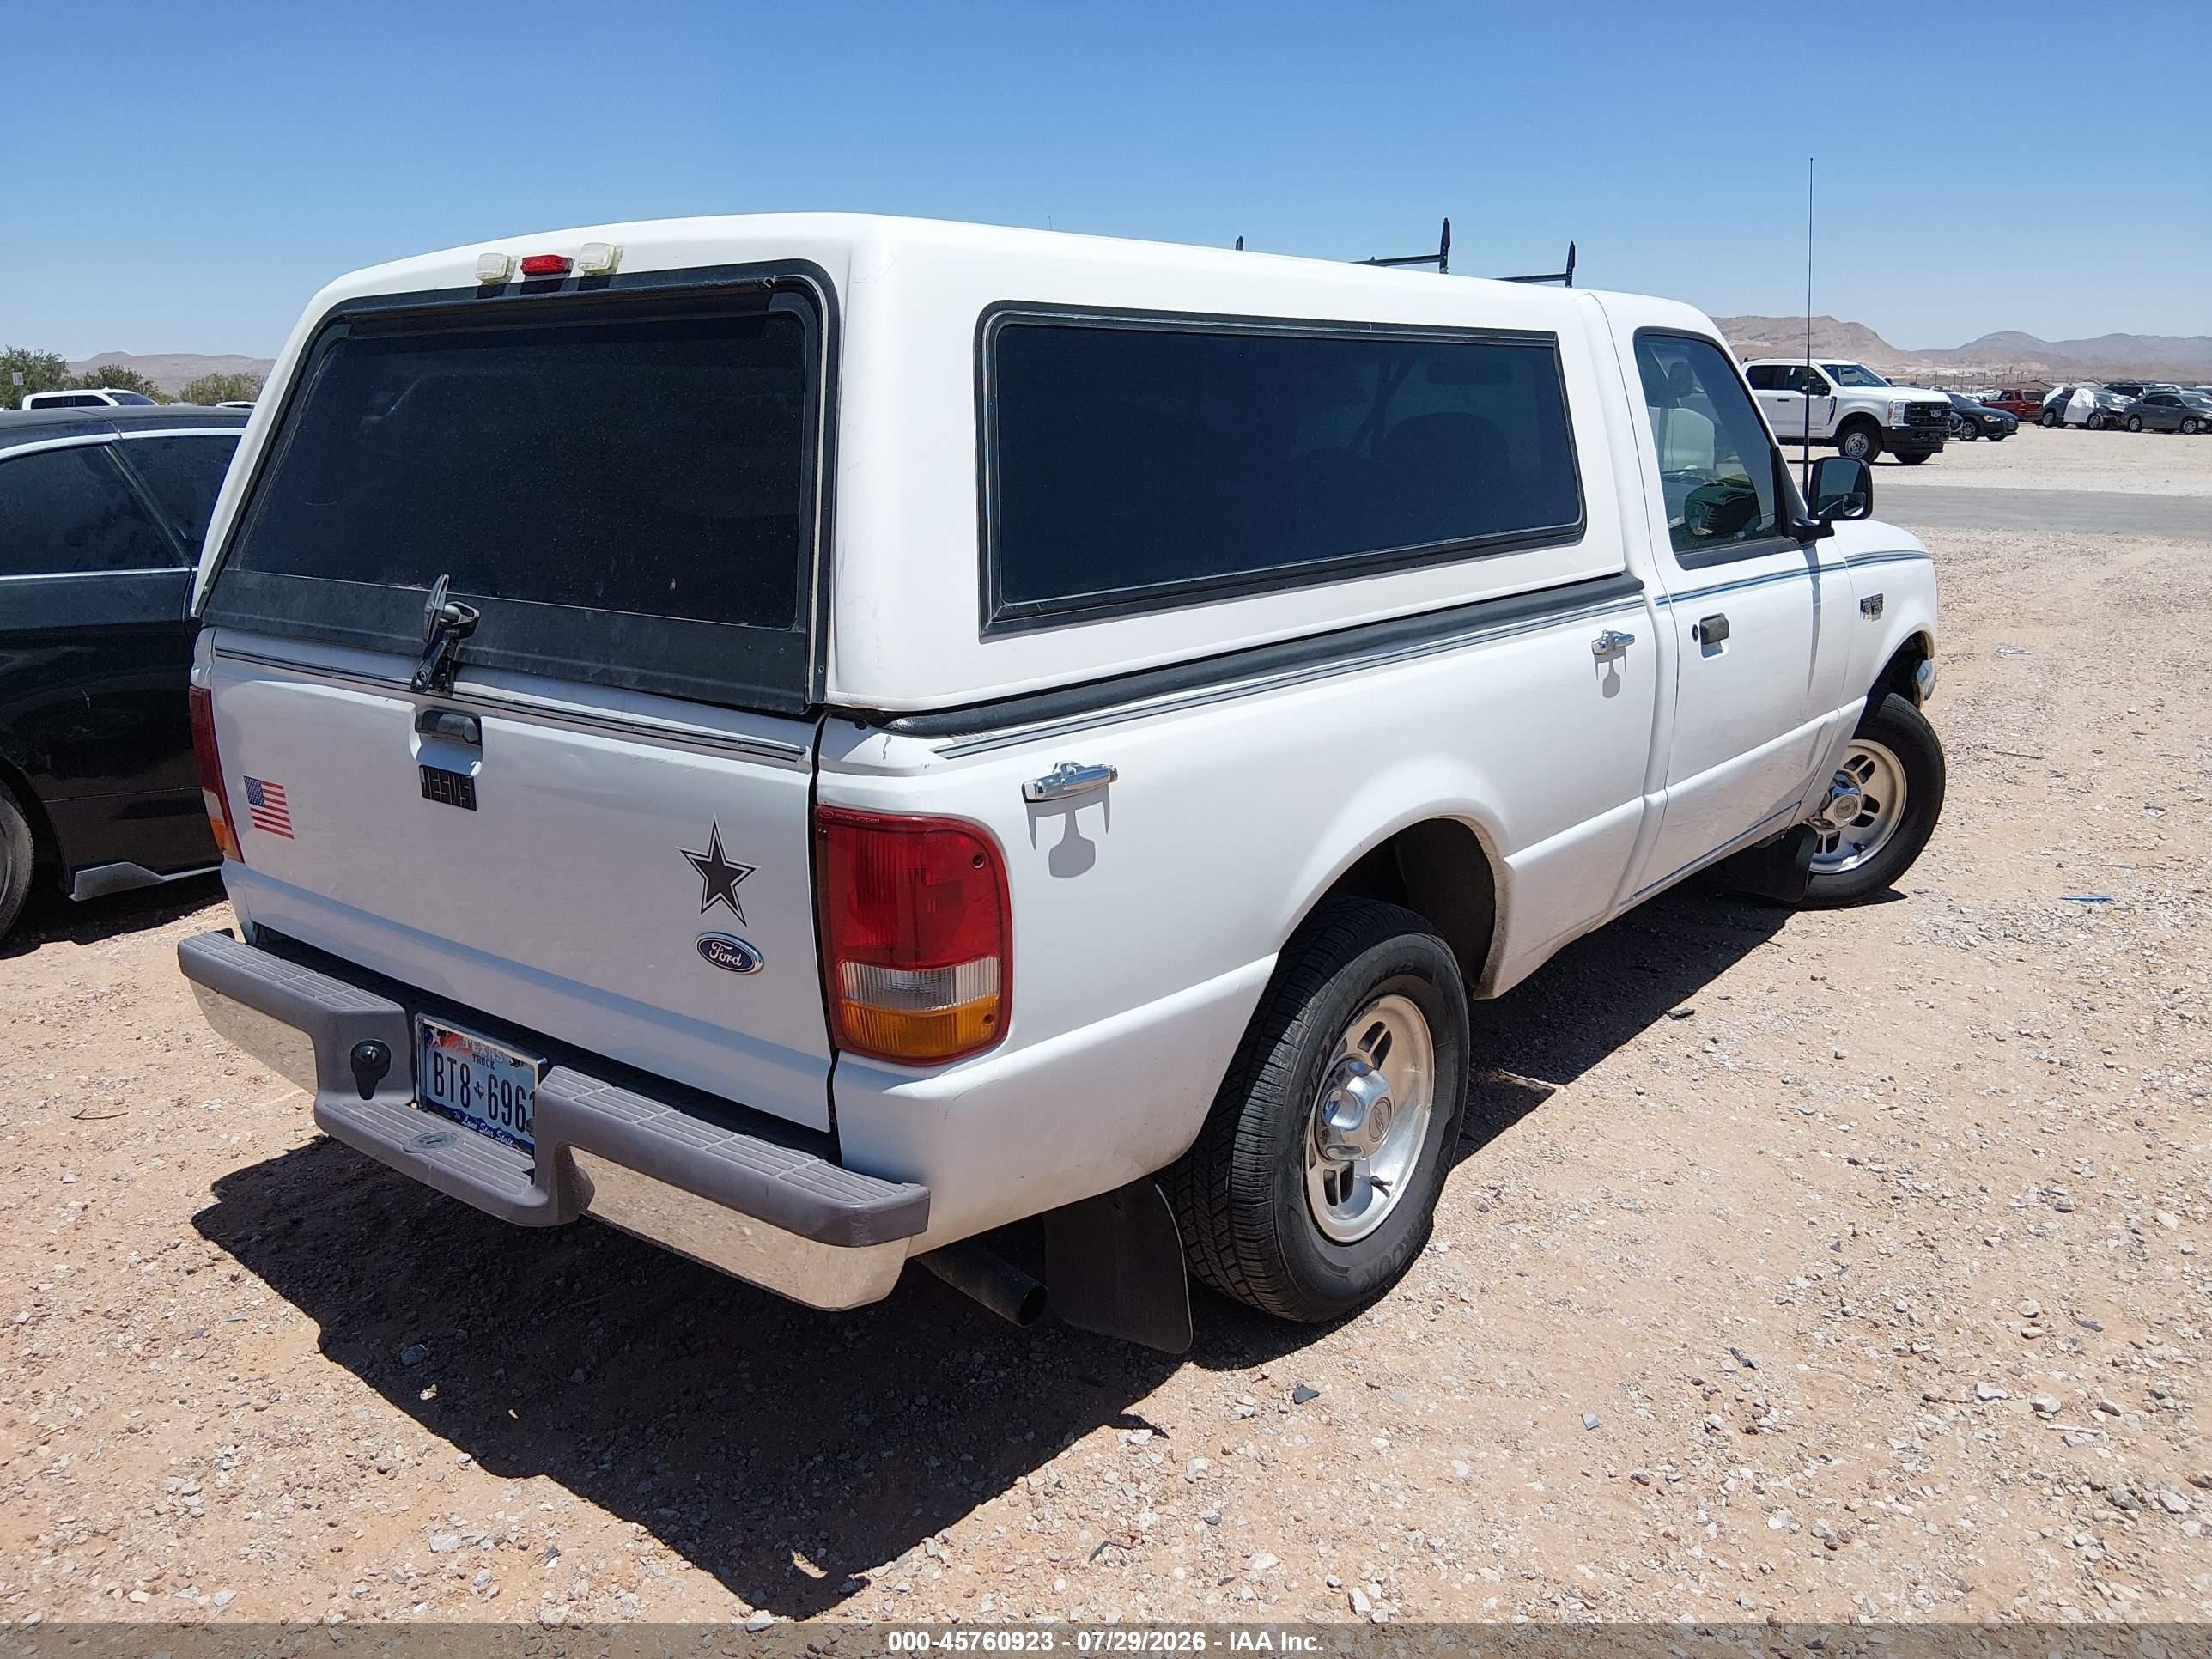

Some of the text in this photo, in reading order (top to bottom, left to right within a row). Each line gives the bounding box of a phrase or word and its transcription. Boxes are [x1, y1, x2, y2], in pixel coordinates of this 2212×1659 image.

[708, 941, 743, 966] Ford
[471, 1053, 495, 1071] TRUCK
[434, 1050, 471, 1109] BT8
[461, 1115, 477, 1130] Lone
[478, 1122, 494, 1138] Star
[495, 1130, 514, 1146] State
